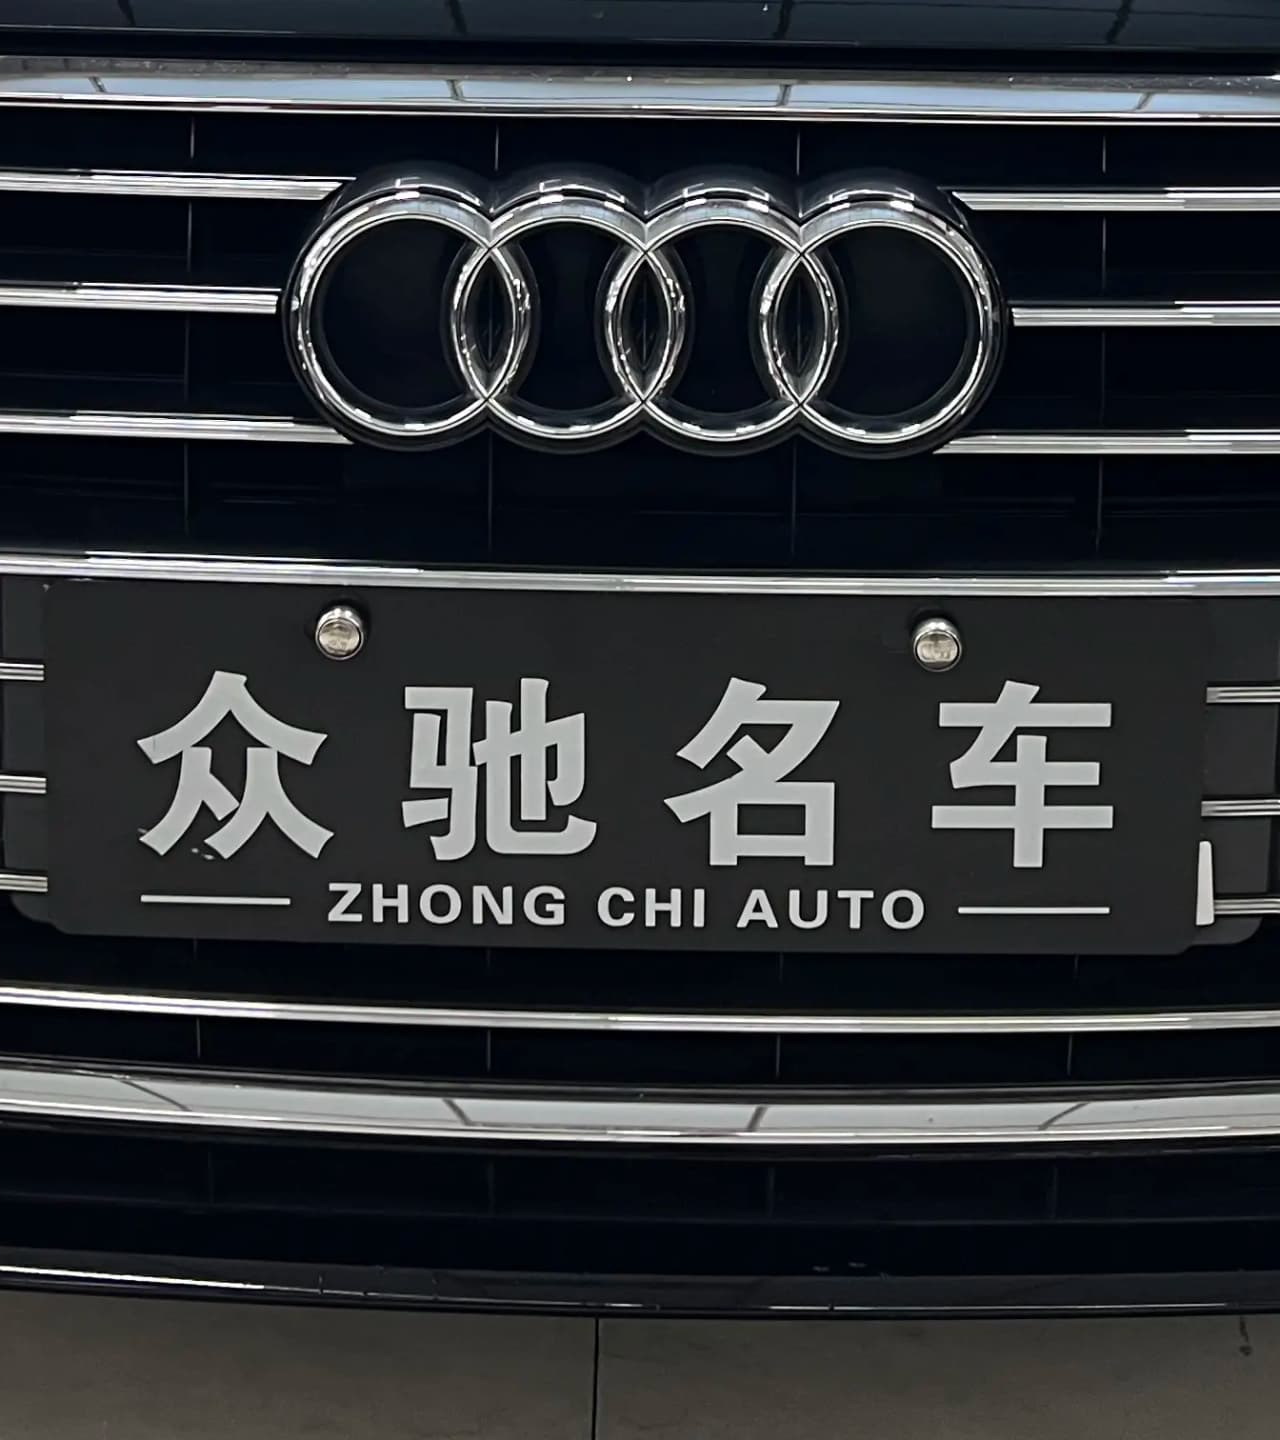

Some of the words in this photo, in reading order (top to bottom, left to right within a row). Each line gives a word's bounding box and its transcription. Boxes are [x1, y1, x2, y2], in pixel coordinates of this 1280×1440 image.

[137, 670, 1115, 869] 众驰名车
[328, 882, 568, 928] ZHONG
[596, 886, 707, 930] CHI
[735, 888, 926, 931] AUTO
